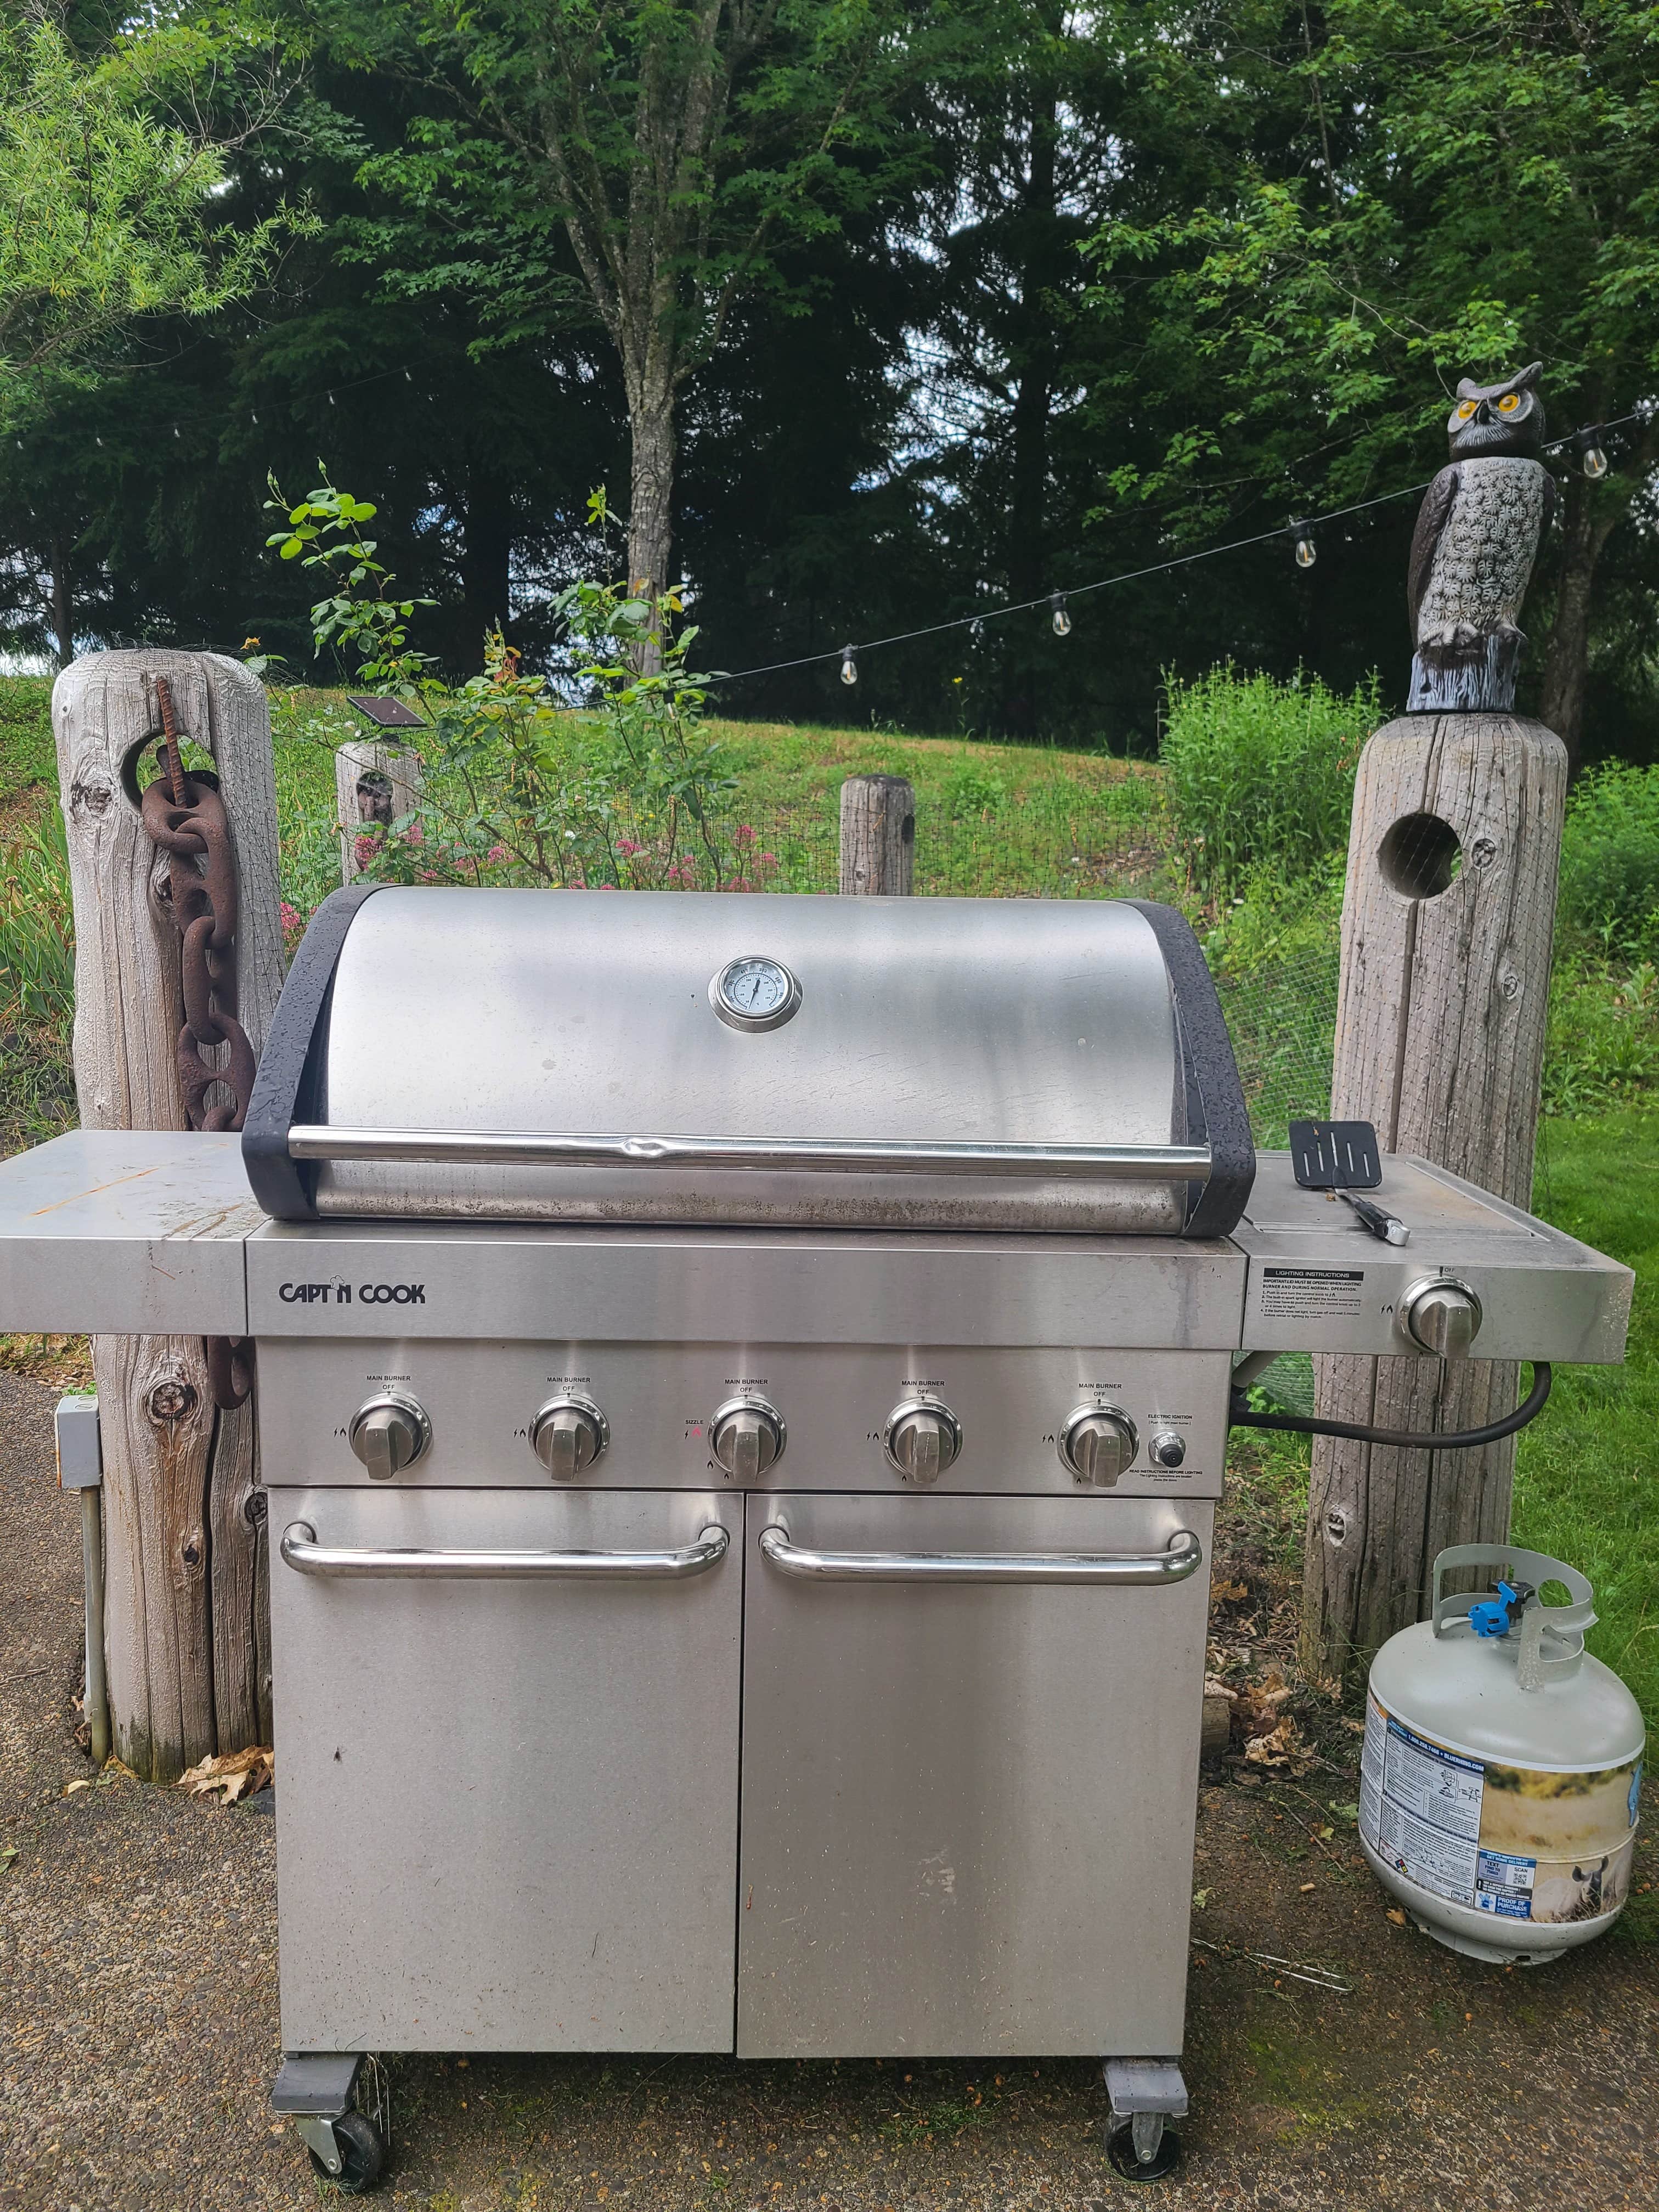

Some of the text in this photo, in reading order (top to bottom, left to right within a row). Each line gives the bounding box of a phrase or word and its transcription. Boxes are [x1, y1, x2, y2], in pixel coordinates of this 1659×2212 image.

[358, 1284, 426, 1304] COOK
[1443, 1753, 1484, 1772] BLUERHINO.COM
[1498, 1901, 1527, 1912] PURCHASE
